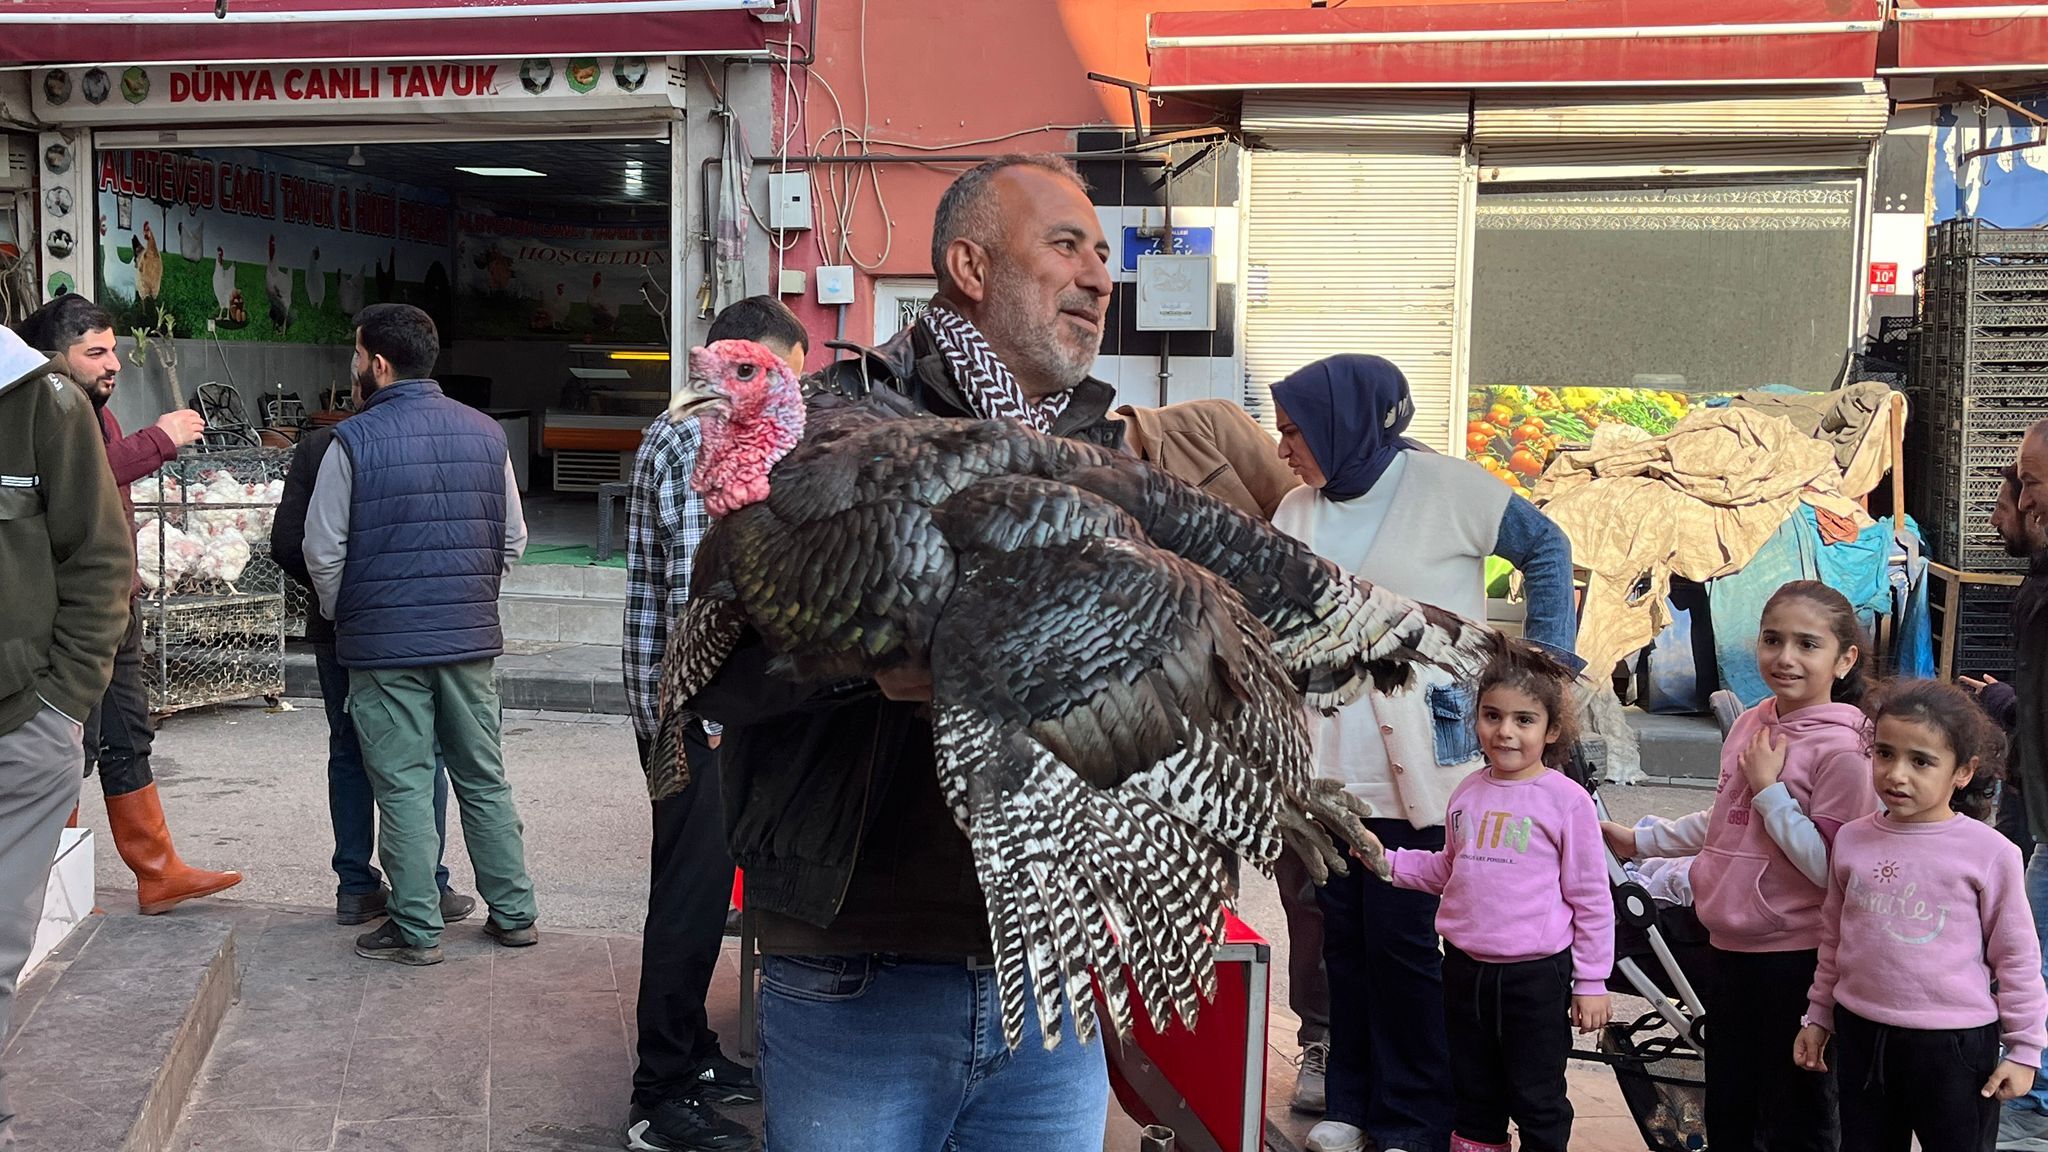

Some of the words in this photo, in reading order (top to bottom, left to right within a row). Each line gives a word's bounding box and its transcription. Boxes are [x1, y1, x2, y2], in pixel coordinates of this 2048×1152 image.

[170, 65, 277, 102] DÜNYA
[284, 67, 379, 99] CANLI
[387, 65, 499, 97] TAVUK
[281, 175, 335, 228] TAVUK
[340, 187, 352, 231] &
[1151, 238, 1189, 248] 72.
